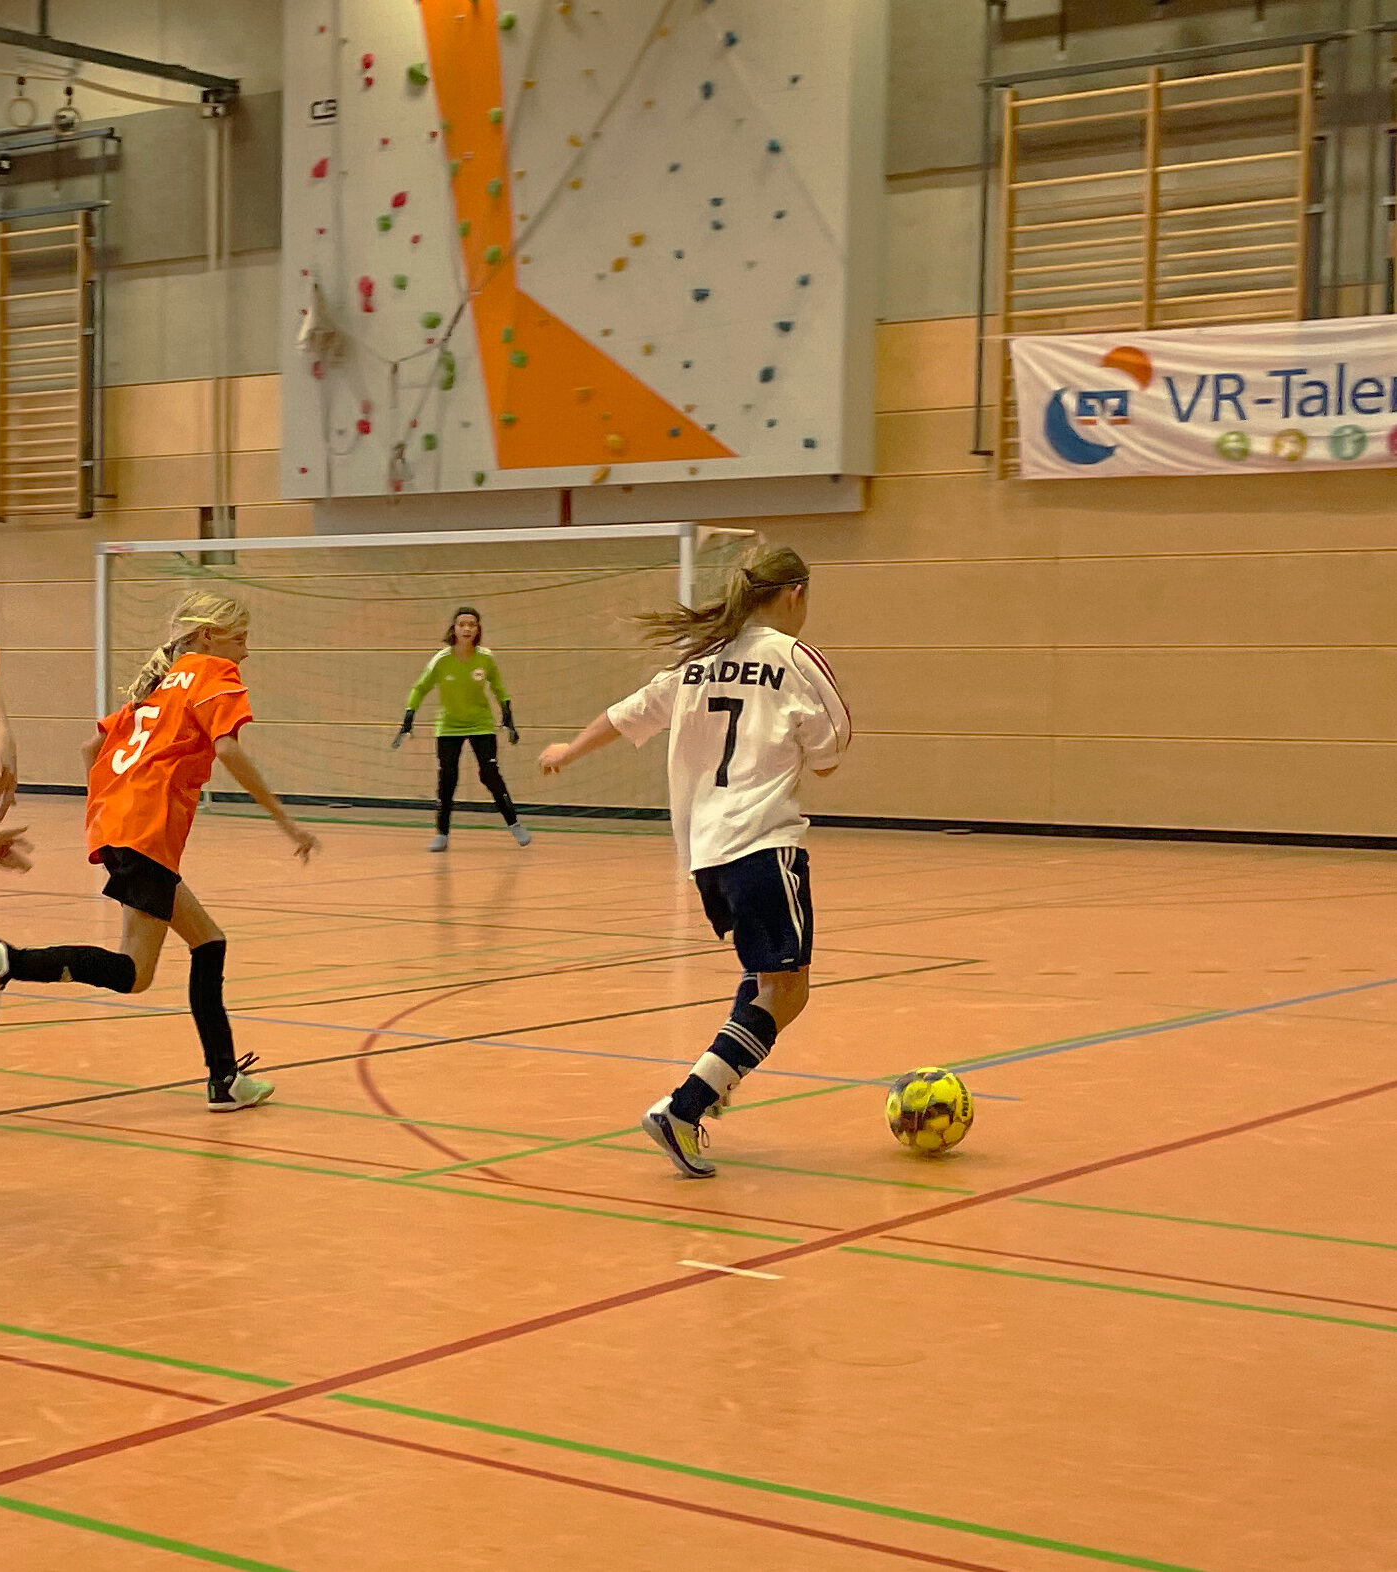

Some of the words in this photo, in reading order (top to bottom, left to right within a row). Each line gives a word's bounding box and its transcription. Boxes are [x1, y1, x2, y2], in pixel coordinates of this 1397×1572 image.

[1163, 362, 1397, 423] VR-Tale
[682, 660, 786, 691] BADEN
[111, 705, 161, 775] 5
[707, 696, 744, 788] 7
